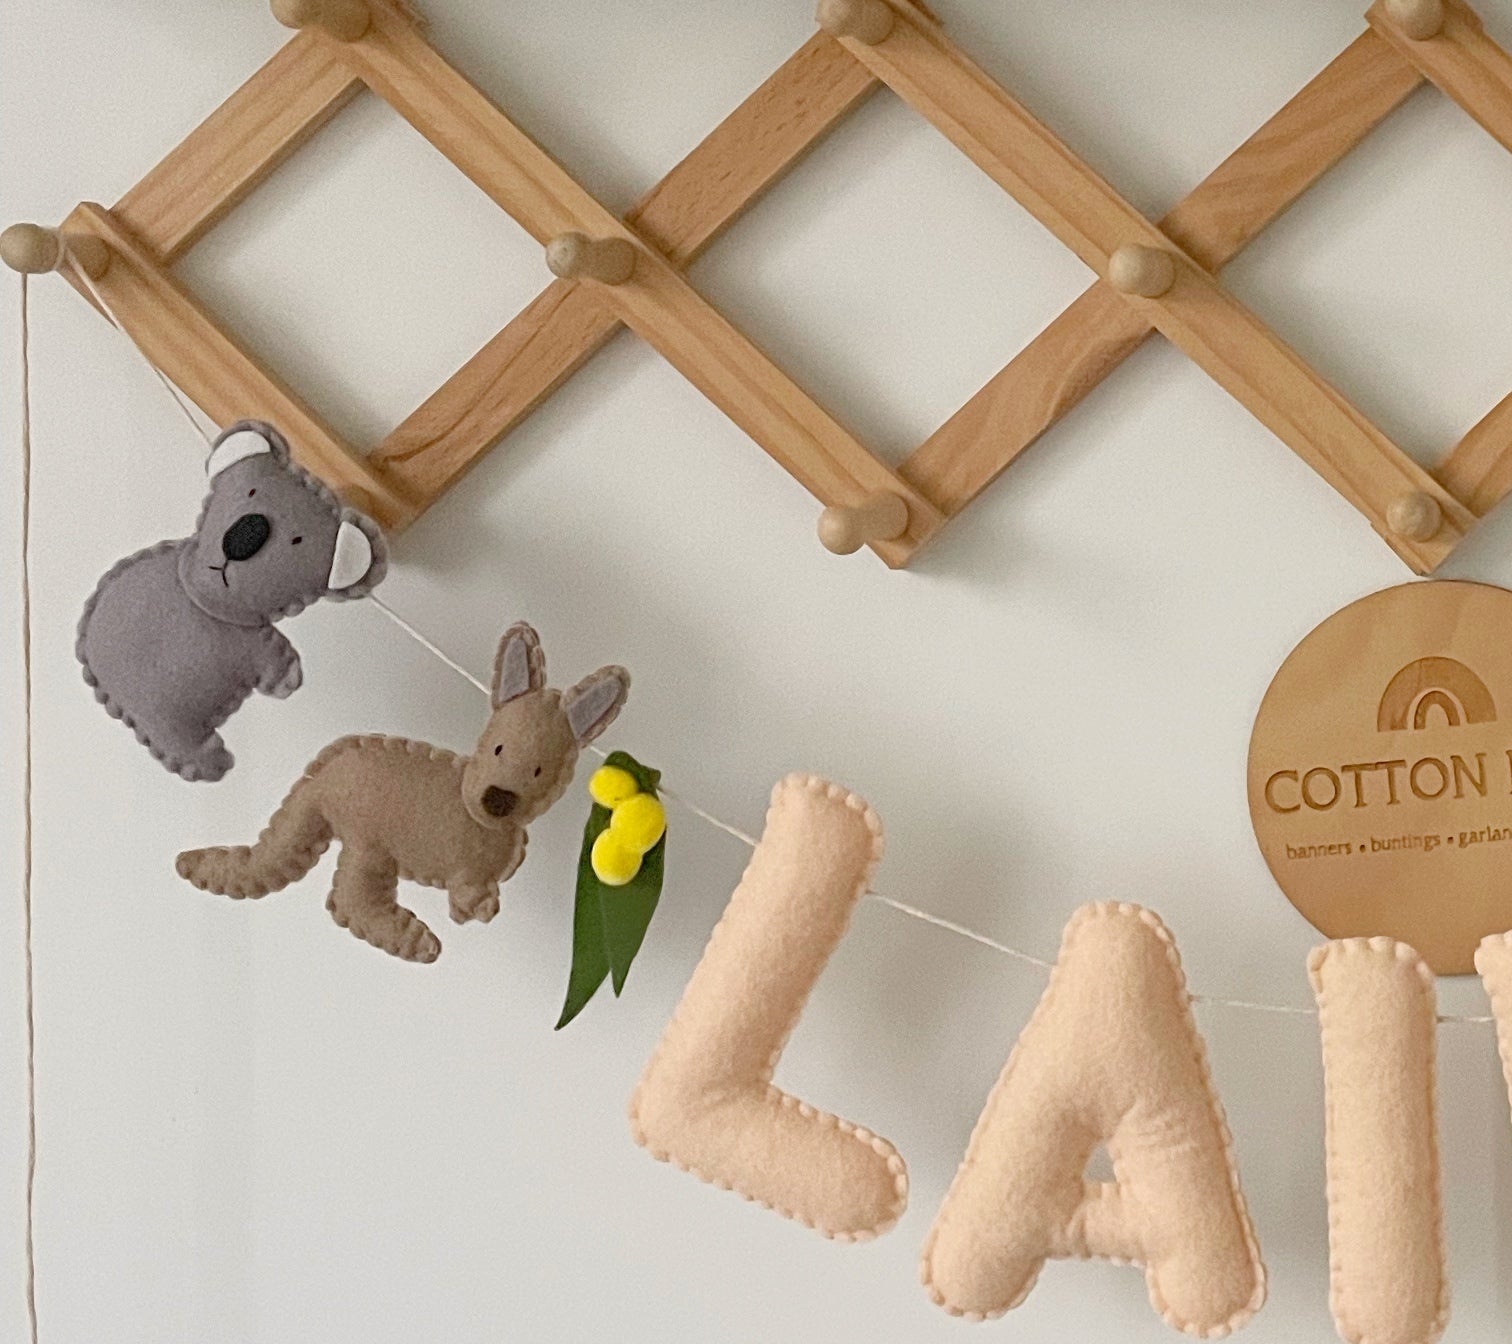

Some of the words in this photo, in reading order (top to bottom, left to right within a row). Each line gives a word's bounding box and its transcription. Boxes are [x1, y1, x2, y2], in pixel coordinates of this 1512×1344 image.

[1264, 751, 1488, 814] COTTON
[1285, 839, 1352, 860] banners
[1370, 834, 1442, 854] buntings
